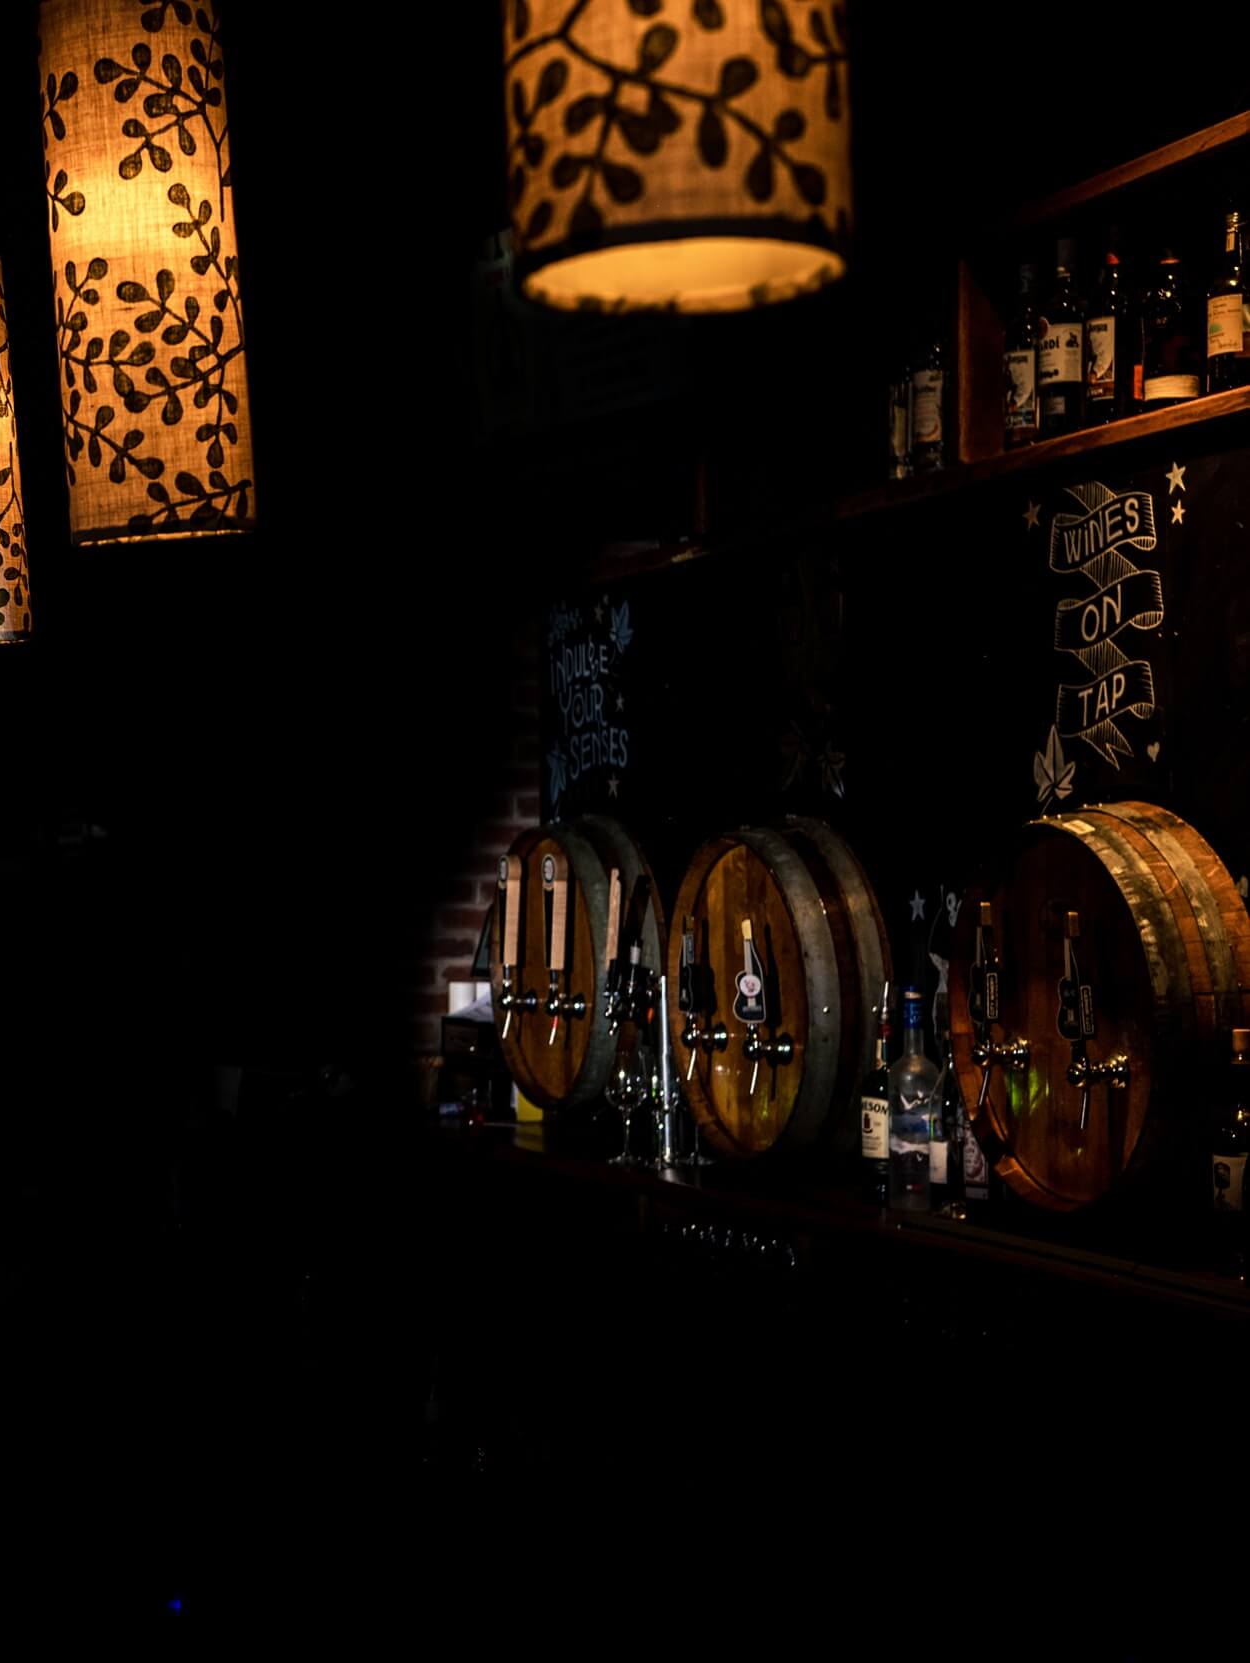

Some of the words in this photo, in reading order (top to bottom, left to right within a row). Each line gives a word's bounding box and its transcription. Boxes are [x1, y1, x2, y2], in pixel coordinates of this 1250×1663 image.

[1063, 497, 1139, 564] WINES
[1081, 584, 1122, 642] ON
[558, 683, 609, 736] YOUR
[1078, 674, 1126, 727] TAP
[569, 727, 628, 781] SENSES
